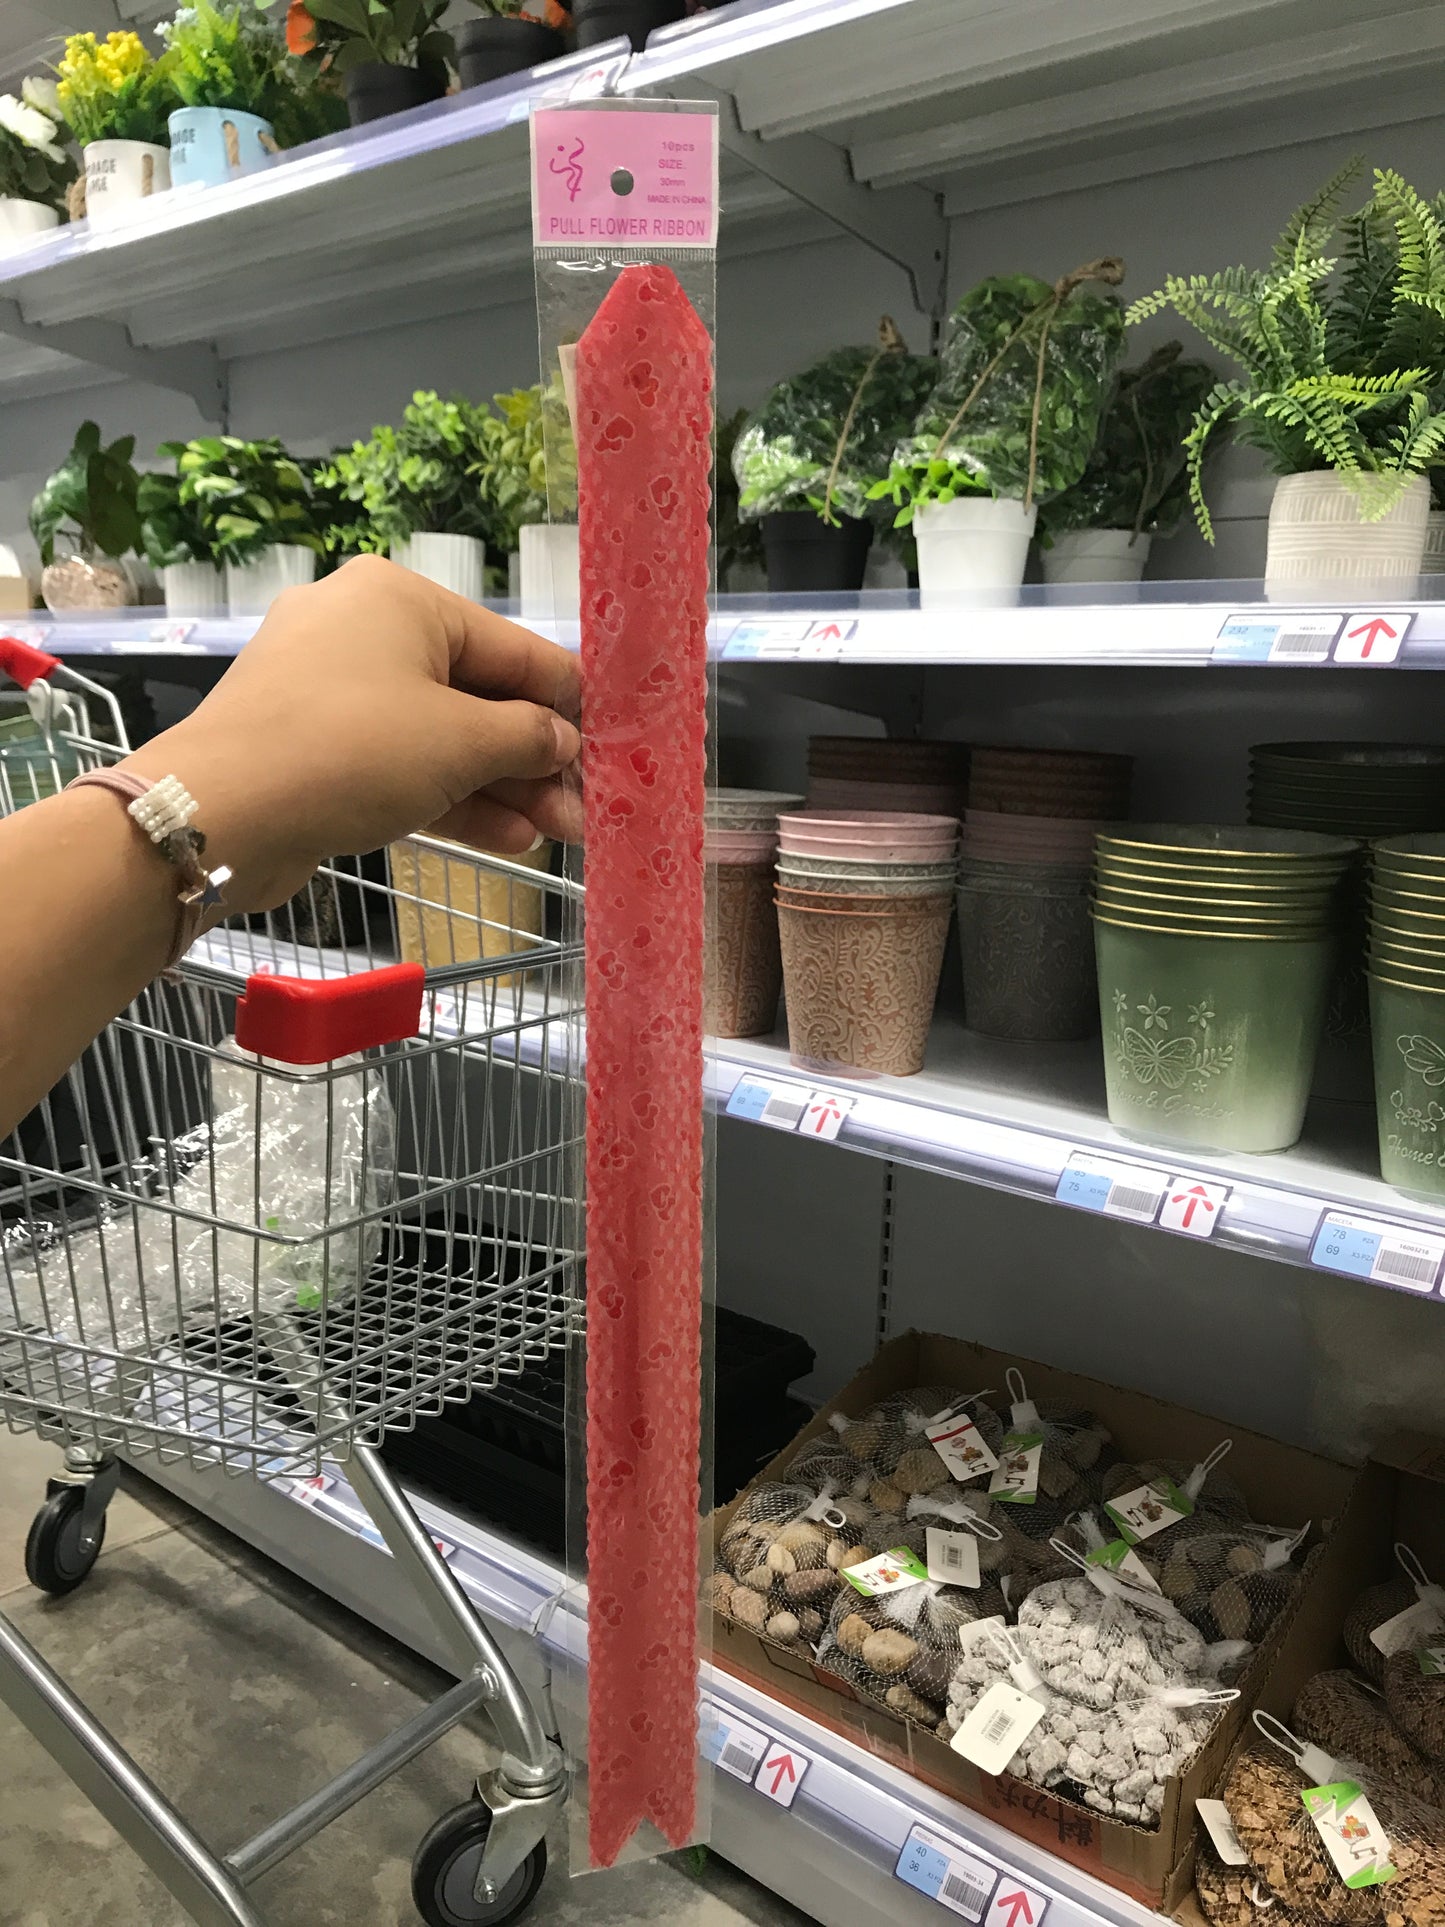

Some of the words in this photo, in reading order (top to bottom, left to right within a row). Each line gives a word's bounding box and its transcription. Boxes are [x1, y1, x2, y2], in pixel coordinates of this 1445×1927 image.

[661, 141, 696, 152] 10pcs
[660, 177, 686, 187] 30mm
[647, 194, 671, 204] MADE
[672, 195, 681, 204] IN
[681, 195, 706, 205] CHINA
[550, 217, 585, 235] PULL
[590, 217, 648, 236] FLOWER
[653, 219, 706, 236] RIBBON
[1145, 1090, 1159, 1108] &
[1162, 1094, 1234, 1120] Garden
[1387, 1134, 1434, 1165] Home
[1068, 1181, 1080, 1193] 75
[1328, 1216, 1353, 1226] MACETA
[1332, 1228, 1348, 1240] 78
[1362, 1237, 1376, 1245] PZA
[1325, 1244, 1341, 1256] 69
[915, 1845, 928, 1858] 40
